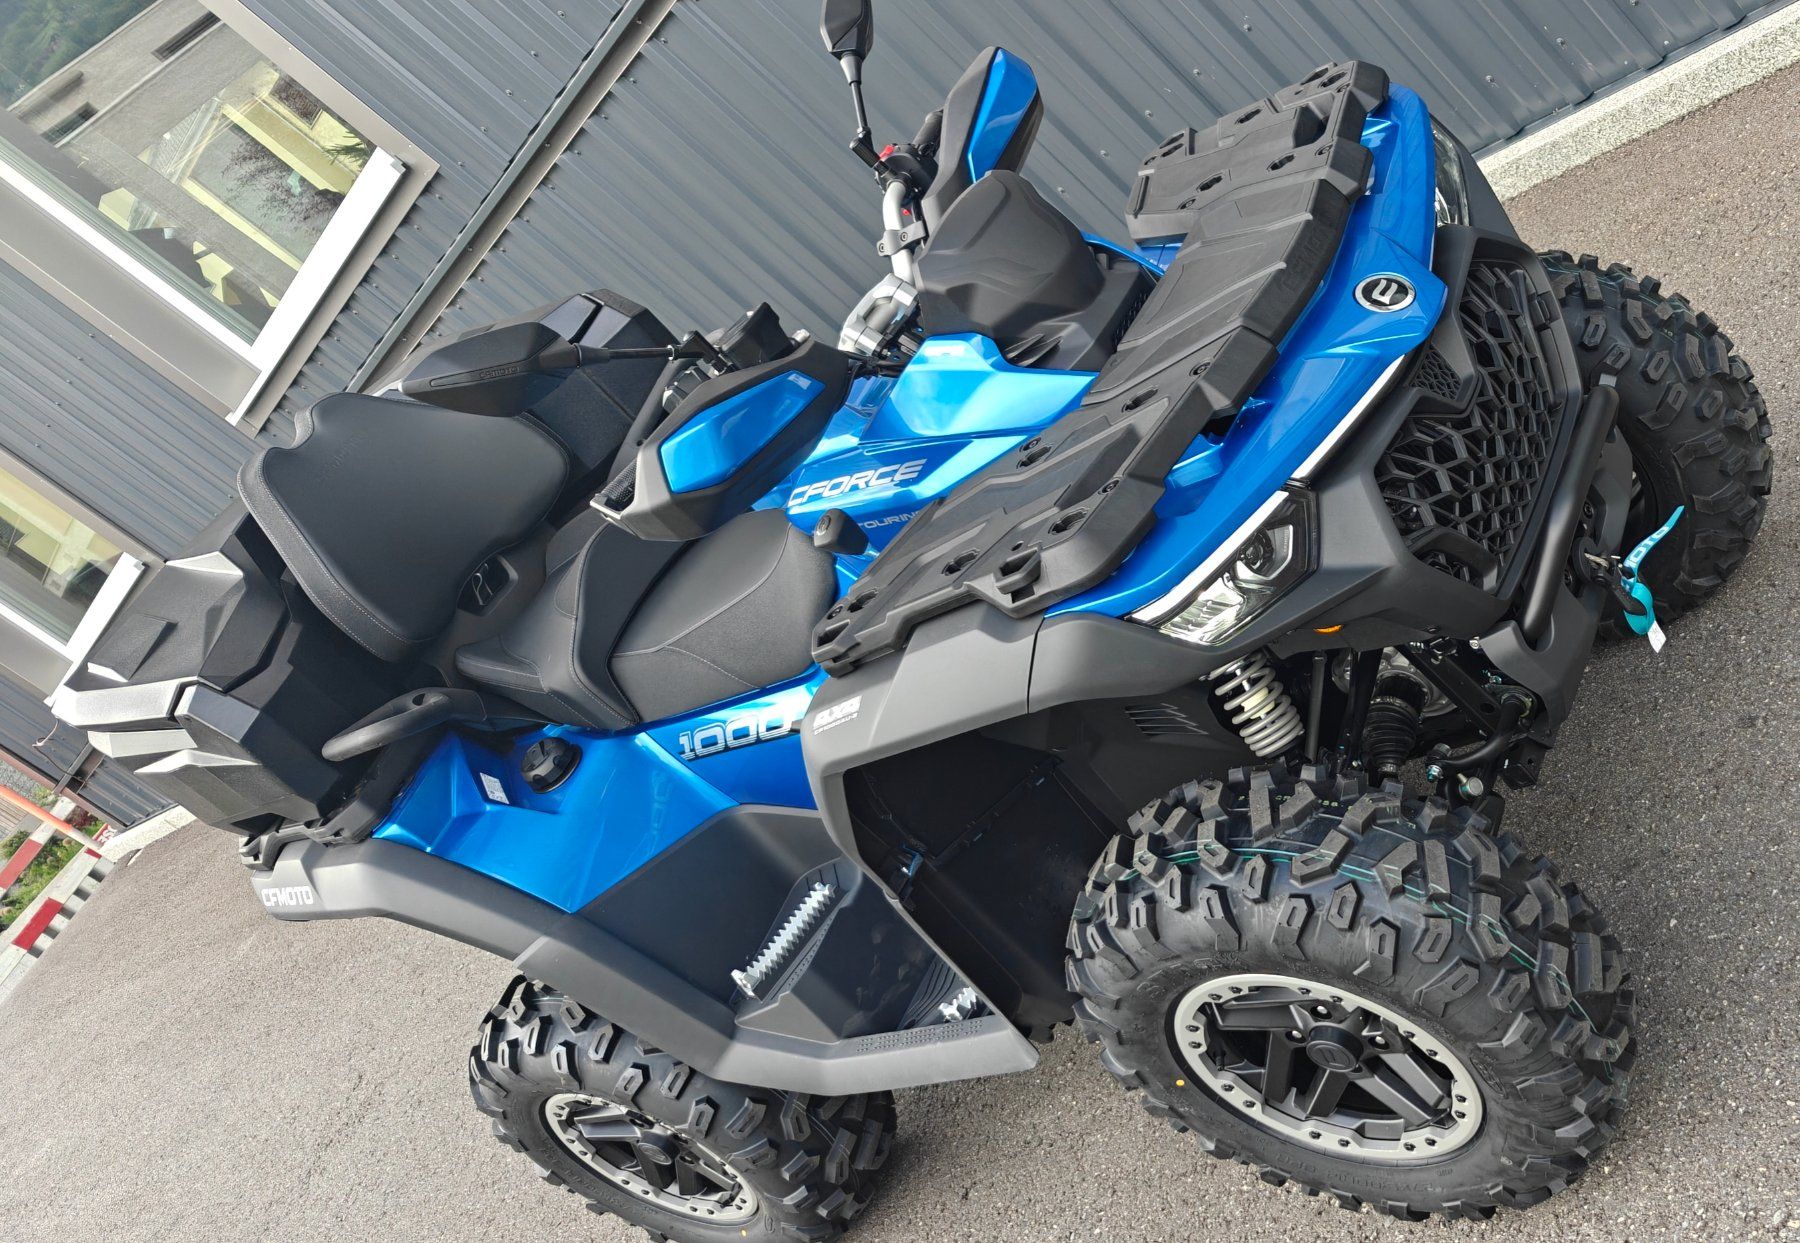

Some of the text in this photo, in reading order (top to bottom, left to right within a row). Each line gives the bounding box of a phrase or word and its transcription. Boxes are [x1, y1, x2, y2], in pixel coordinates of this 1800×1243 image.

[787, 459, 927, 507] CFORCE
[679, 707, 793, 761] 1000
[261, 885, 314, 907] CFMOTO
